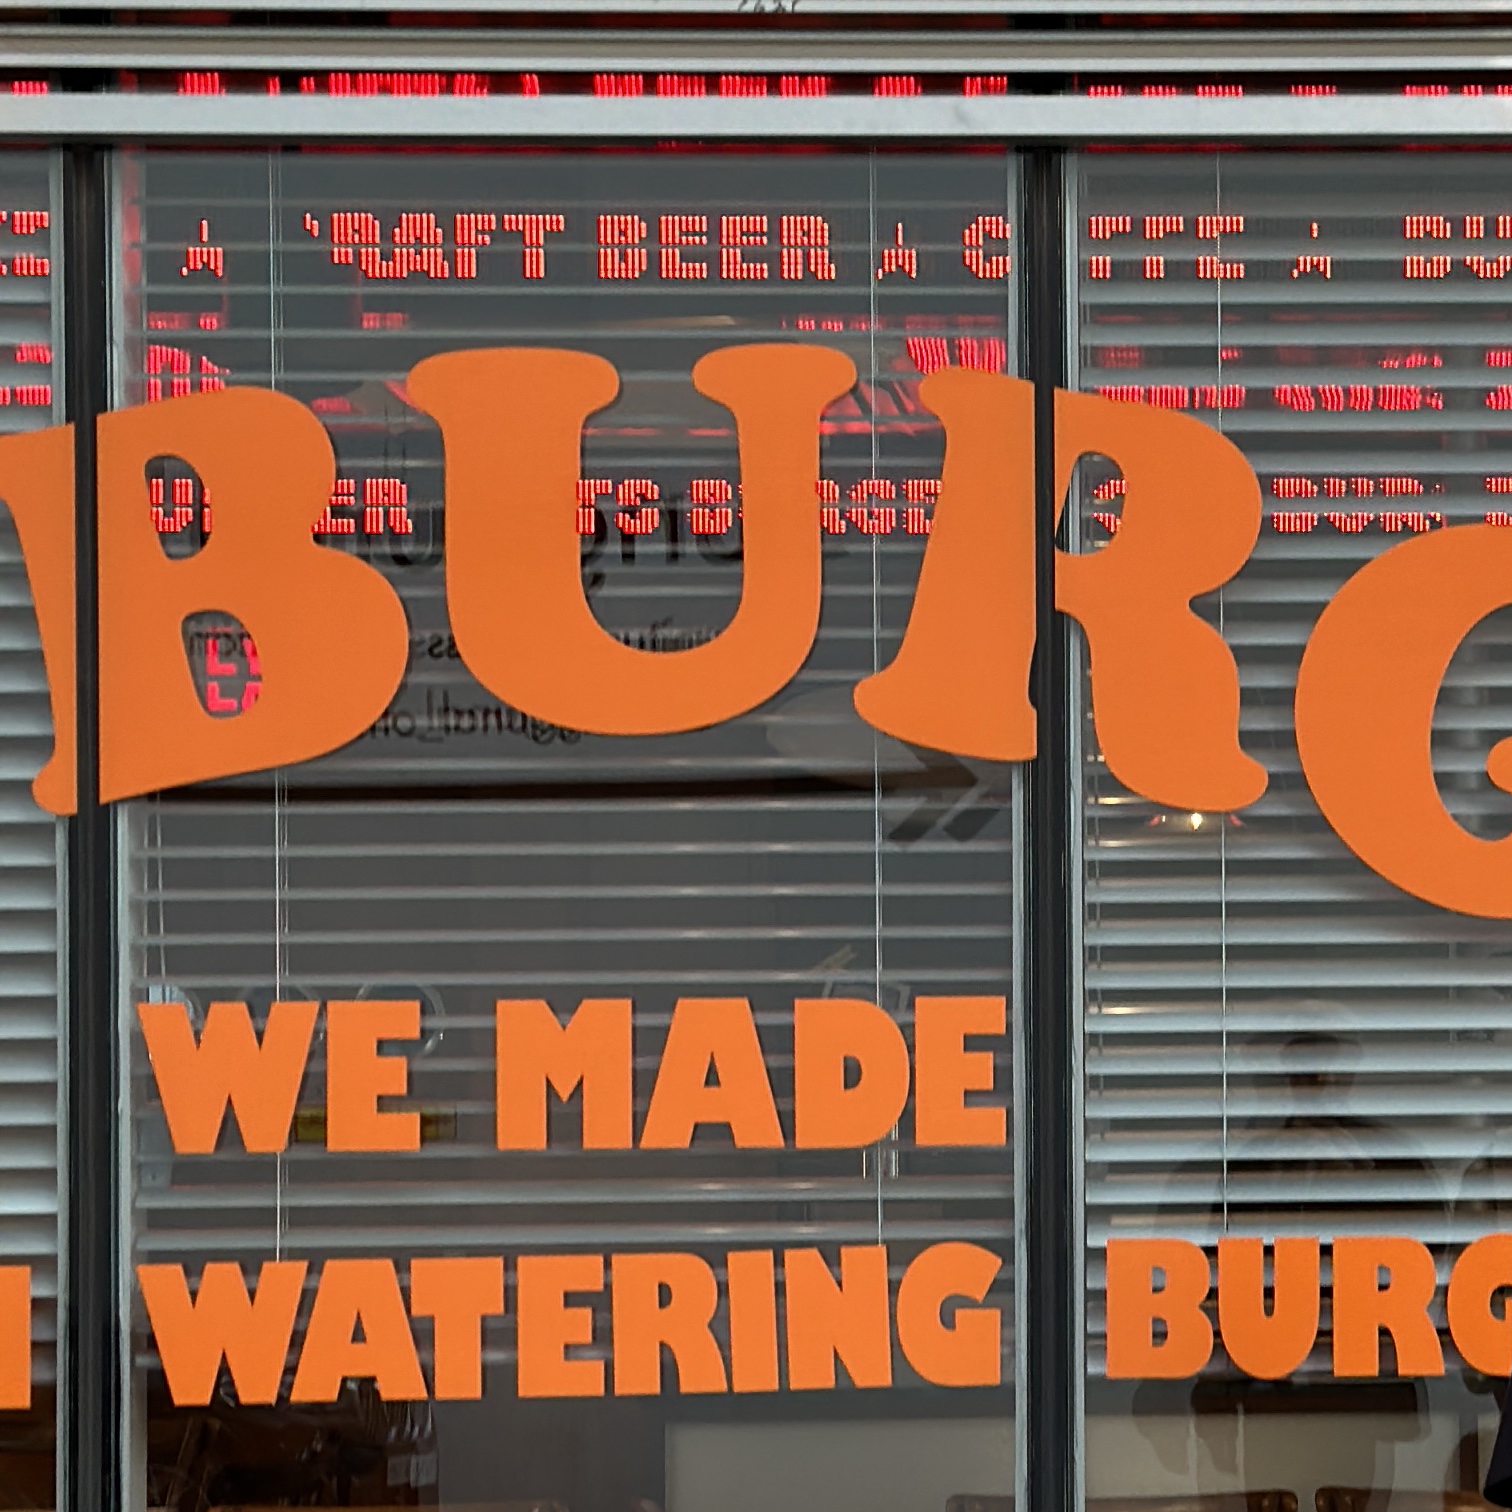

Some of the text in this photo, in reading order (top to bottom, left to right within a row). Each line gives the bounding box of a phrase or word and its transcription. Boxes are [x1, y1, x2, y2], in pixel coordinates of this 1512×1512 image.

[302, 213, 565, 278] RAFT
[597, 215, 836, 279] BEER
[138, 997, 1005, 1154] WE MADE
[138, 1242, 1001, 1405] WATERING
